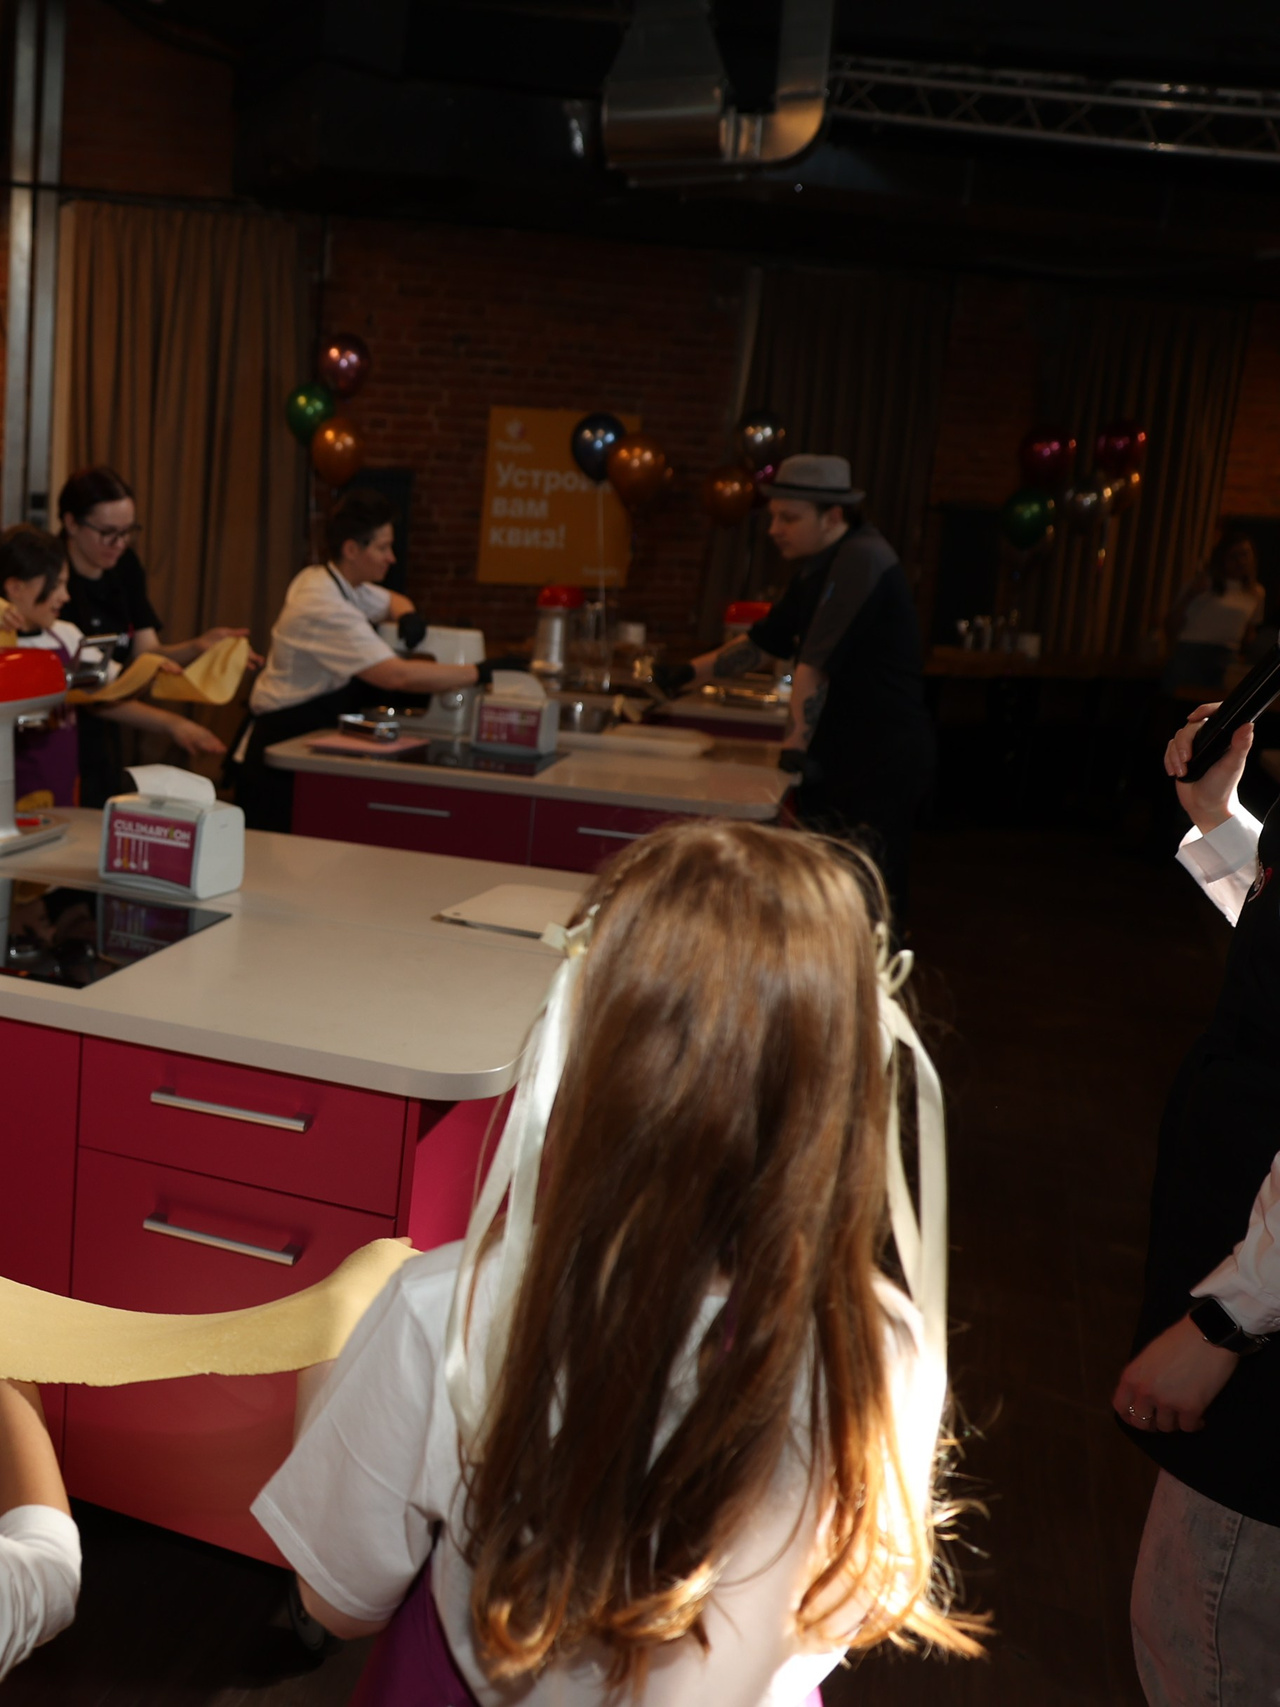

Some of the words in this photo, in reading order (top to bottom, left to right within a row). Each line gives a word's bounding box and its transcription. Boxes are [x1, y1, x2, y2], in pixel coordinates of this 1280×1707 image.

[491, 496, 549, 519] вам
[489, 523, 566, 549] квиз!
[113, 819, 170, 838] CULINARY
